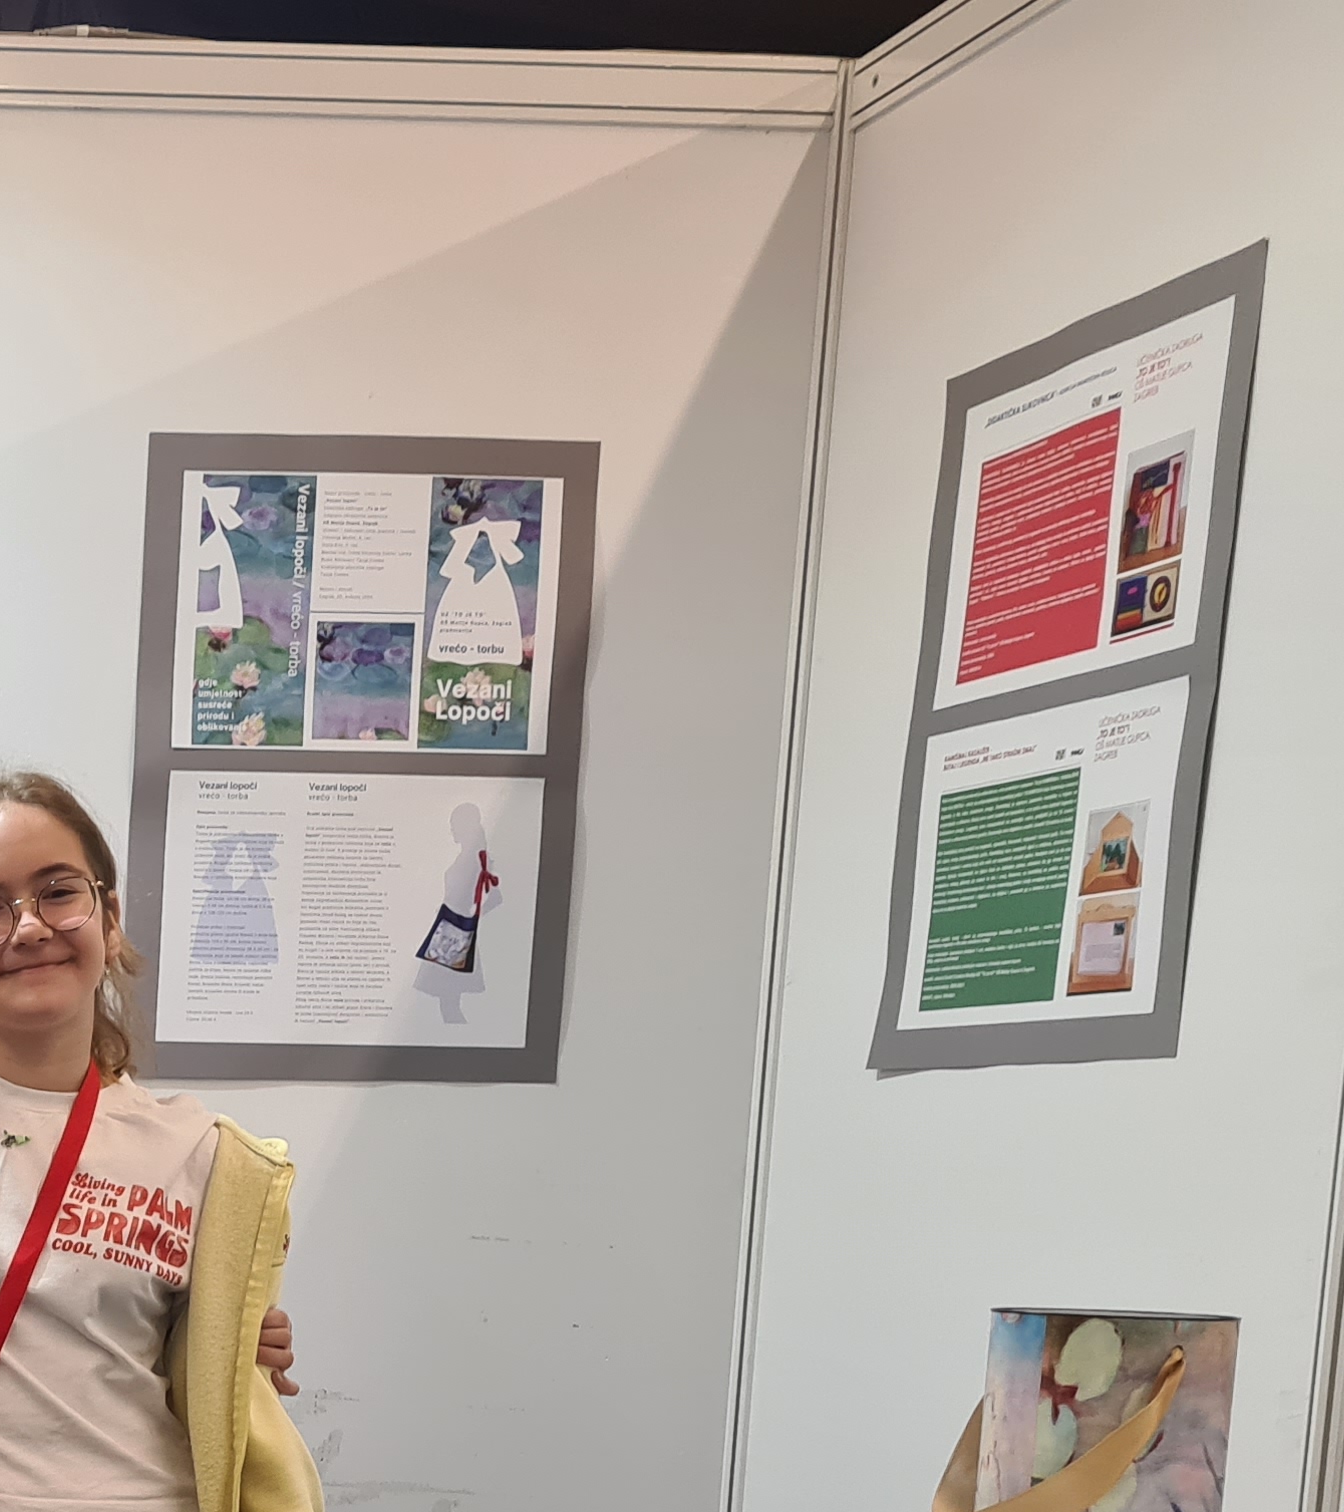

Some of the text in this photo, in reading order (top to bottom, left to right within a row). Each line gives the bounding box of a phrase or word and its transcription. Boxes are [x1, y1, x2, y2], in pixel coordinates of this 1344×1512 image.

[296, 484, 311, 532] Vezani
[292, 536, 308, 578] lopoči
[288, 641, 301, 678] torba
[477, 644, 505, 654] torbu
[198, 678, 218, 688] gdje
[198, 690, 242, 699] umjetnost
[436, 679, 512, 700] Vezani
[197, 712, 229, 722] prirodu
[436, 701, 511, 725] Lopoči
[199, 781, 257, 792] Vezani lopoči
[309, 783, 367, 793] Vezani lopoči
[71, 1172, 126, 1196] Living
[69, 1185, 193, 1235] life in PALM
[55, 1202, 190, 1268] SPRINGS
[52, 1238, 183, 1287] COOL, SUNNY DAYS
